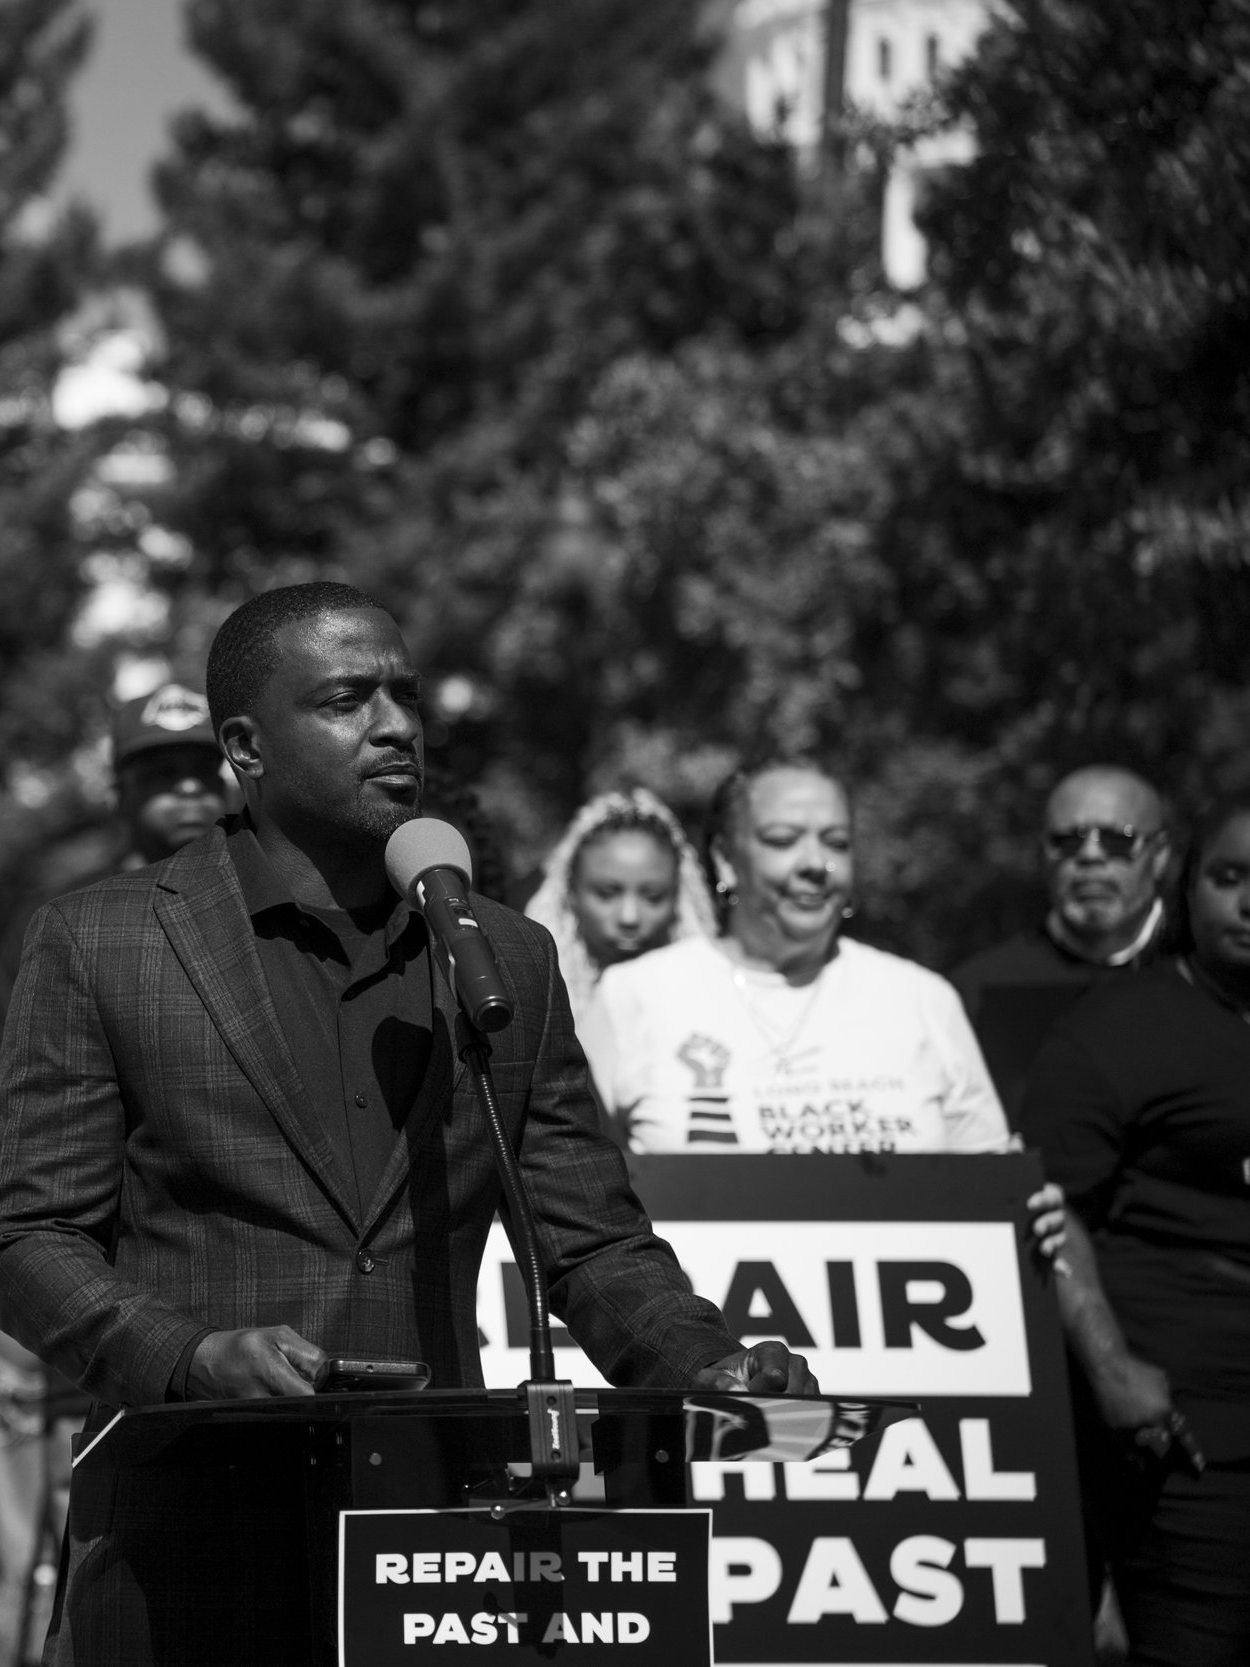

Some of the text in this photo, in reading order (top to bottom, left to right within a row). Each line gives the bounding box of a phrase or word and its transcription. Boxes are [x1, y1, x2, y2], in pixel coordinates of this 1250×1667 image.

[758, 1098, 865, 1122] BLACK
[759, 1115, 918, 1140] WORKER
[375, 1551, 677, 1584] REPAIR THE
[712, 1535, 1047, 1627] PAST
[403, 1611, 651, 1645] PAST AND
